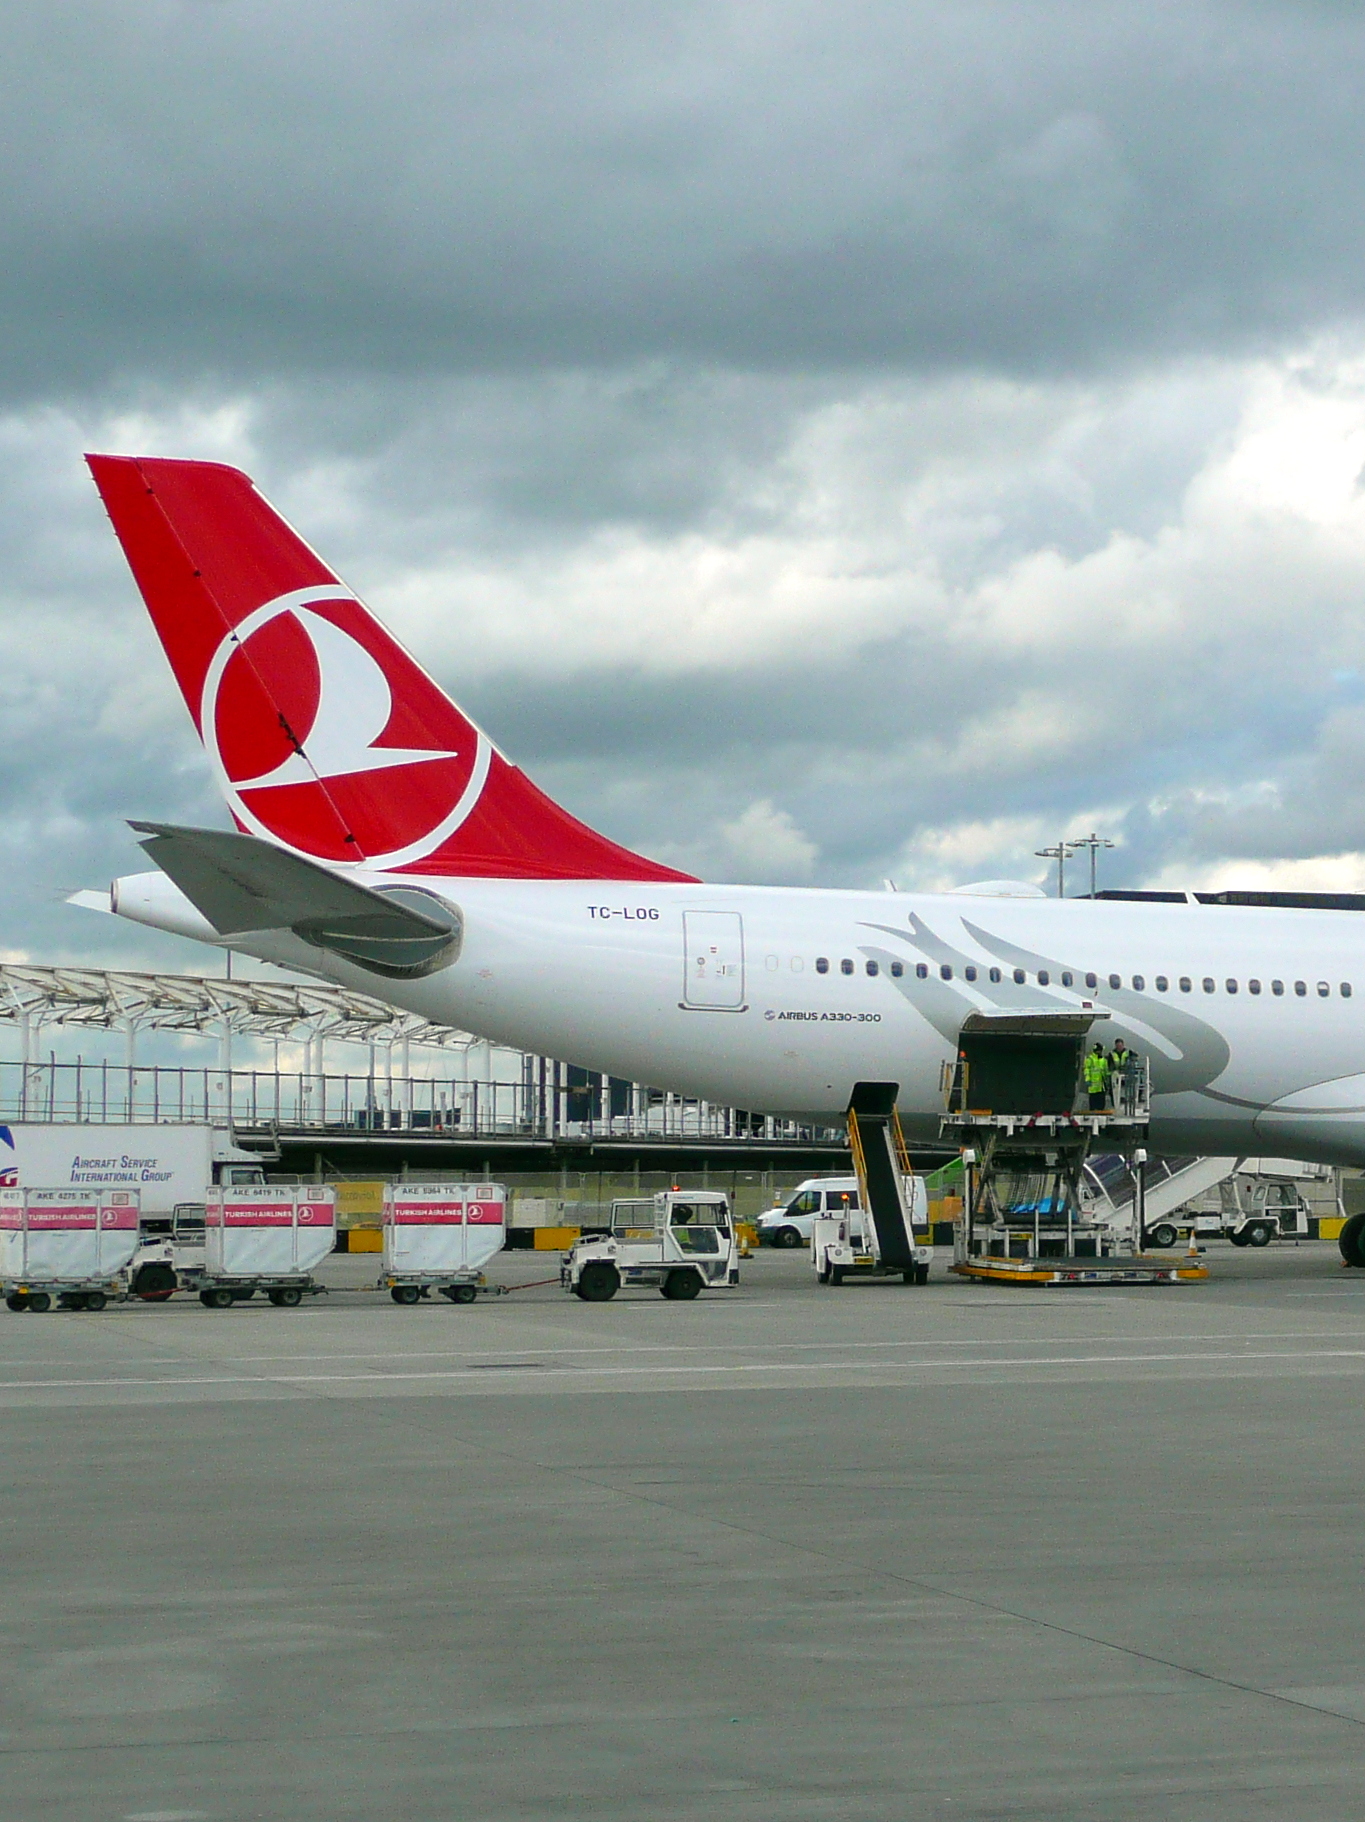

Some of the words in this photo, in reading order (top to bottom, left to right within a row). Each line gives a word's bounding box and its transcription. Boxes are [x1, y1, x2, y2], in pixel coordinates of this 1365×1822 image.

[587, 906, 660, 920] TC-LOG
[777, 1011, 819, 1021] AIRBUS
[820, 1012, 882, 1022] A330-300
[71, 1156, 118, 1169] AIRCRAFT
[120, 1156, 158, 1169] SERVICE
[69, 1169, 139, 1183] INTERNATIONAL
[28, 1213, 62, 1221] TURKISH
[63, 1213, 97, 1221] AIRLINES
